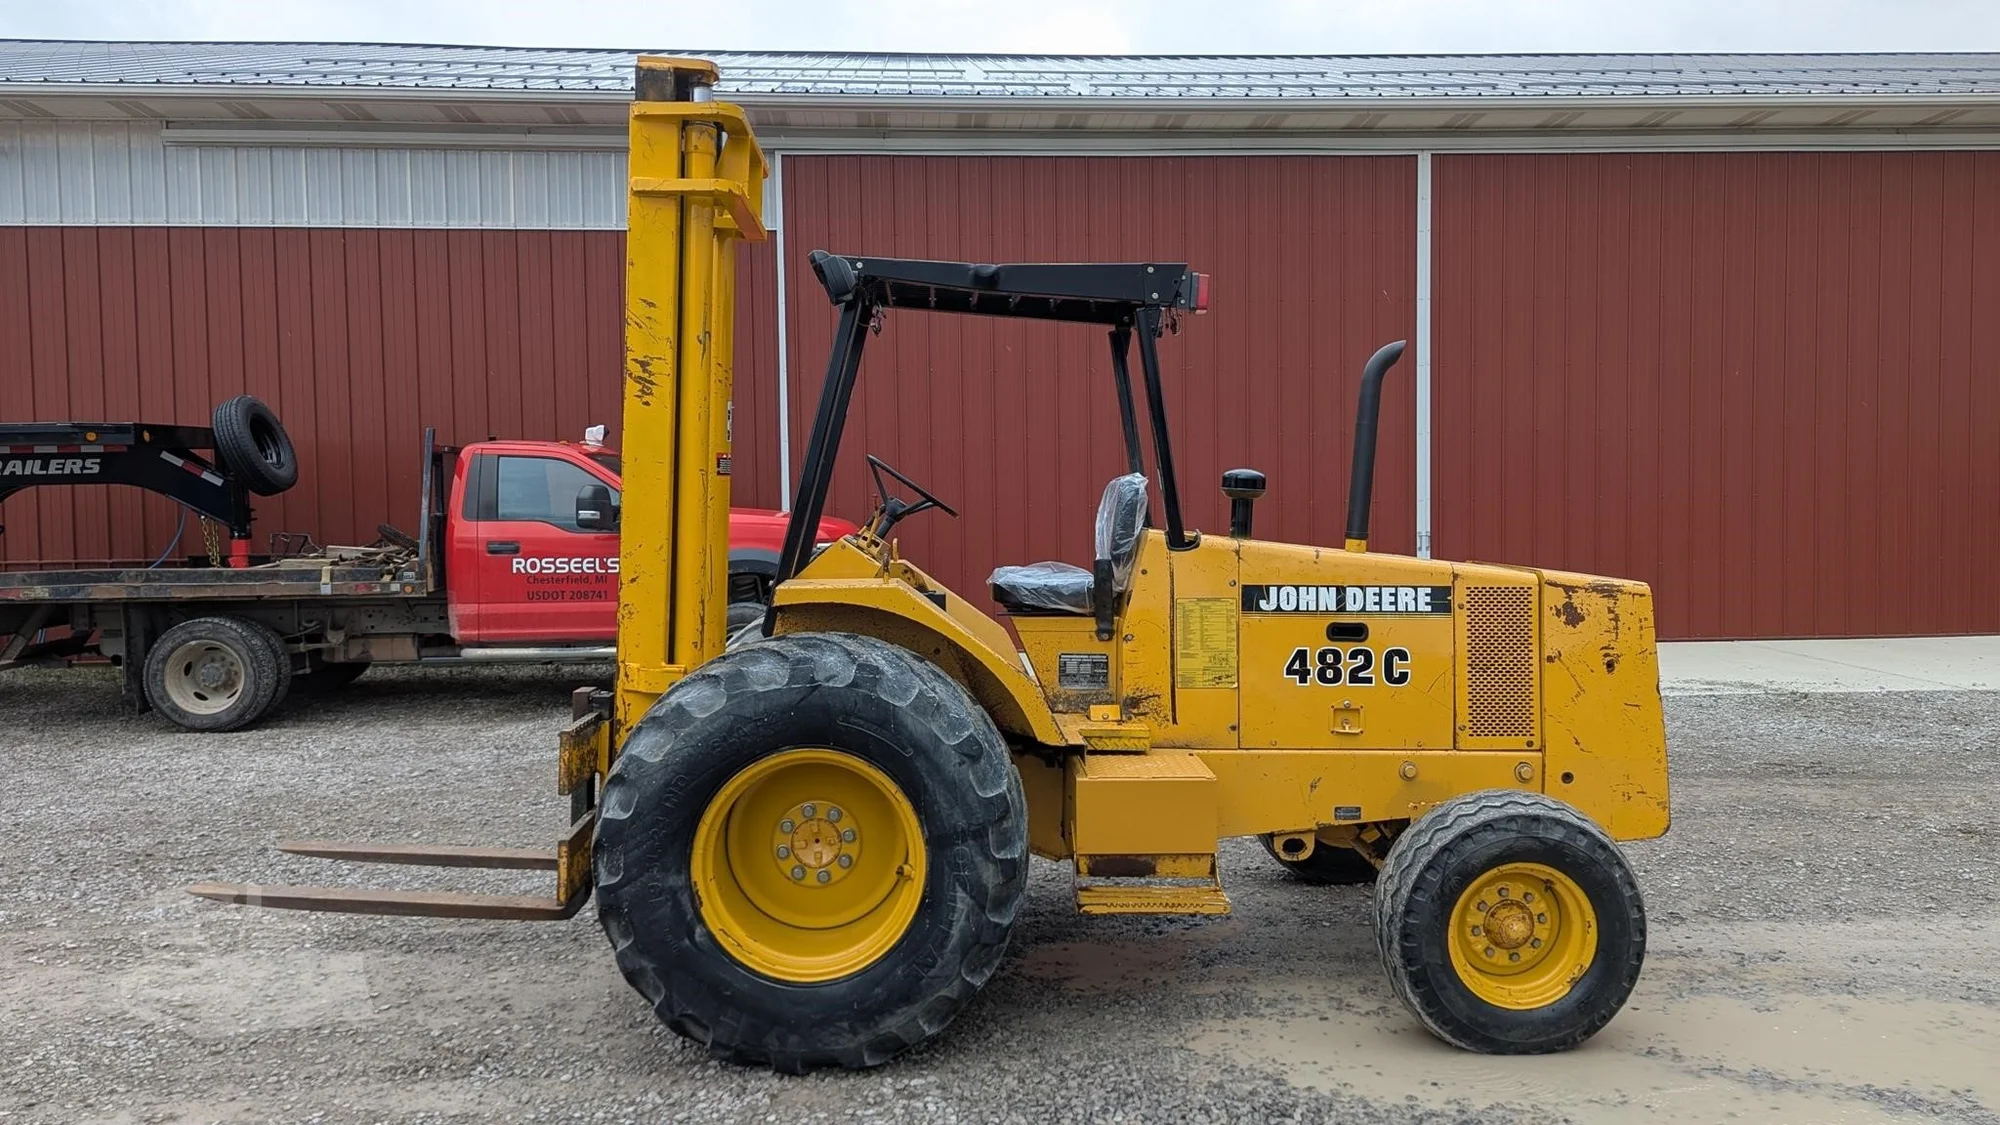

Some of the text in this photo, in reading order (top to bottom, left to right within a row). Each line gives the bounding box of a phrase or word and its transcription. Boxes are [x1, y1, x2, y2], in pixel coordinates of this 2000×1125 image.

[0, 459, 101, 475] AILERS
[512, 557, 620, 574] ROSSEEL'S
[526, 575, 608, 585] Chesterfield, MI
[527, 590, 608, 600] USDOT 208741
[1259, 586, 1432, 612] JOHN DEERE
